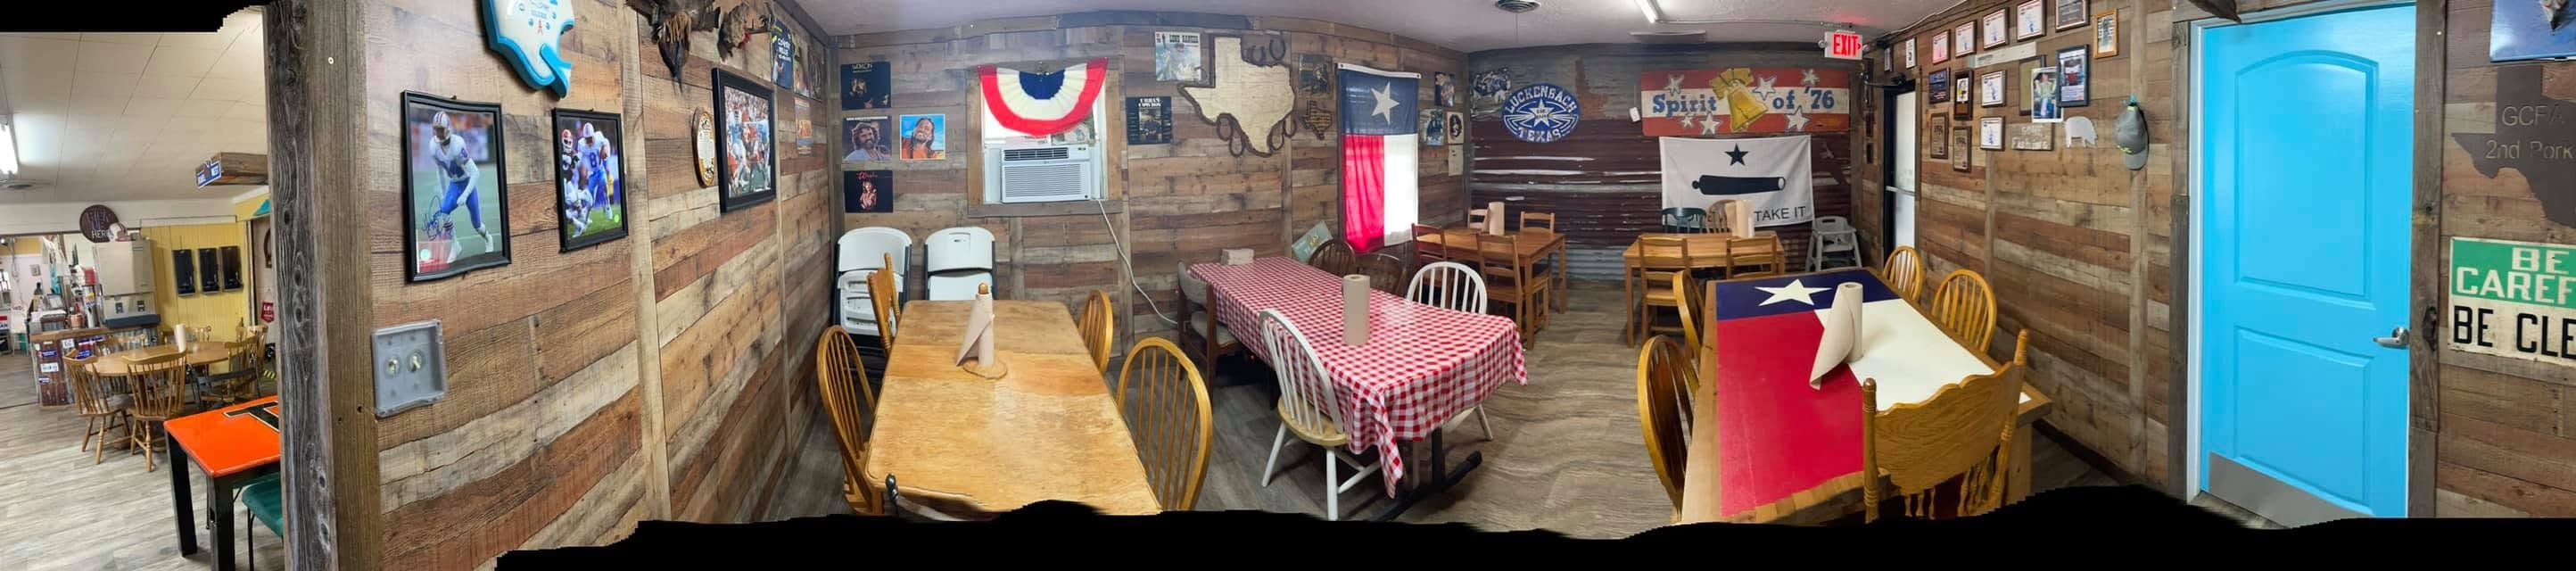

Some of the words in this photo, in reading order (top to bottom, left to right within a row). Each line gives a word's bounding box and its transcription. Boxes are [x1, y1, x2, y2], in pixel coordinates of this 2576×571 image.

[1833, 34, 1858, 56] EXIT
[1505, 86, 1577, 113] LUCKENBACH
[1652, 94, 1717, 117] Spirit
[1772, 90, 1795, 109] of
[1804, 86, 1835, 109] '76
[1517, 127, 1561, 142] TEXAS
[2485, 139, 2520, 159] 2nd
[2530, 140, 2573, 159] Pork
[1754, 209, 1789, 222] TAKE
[1795, 206, 1806, 218] IT
[2511, 247, 2570, 275] BE
[2456, 267, 2576, 304] CAREF
[2453, 305, 2494, 348] BE
[2516, 312, 2576, 360] CLE
